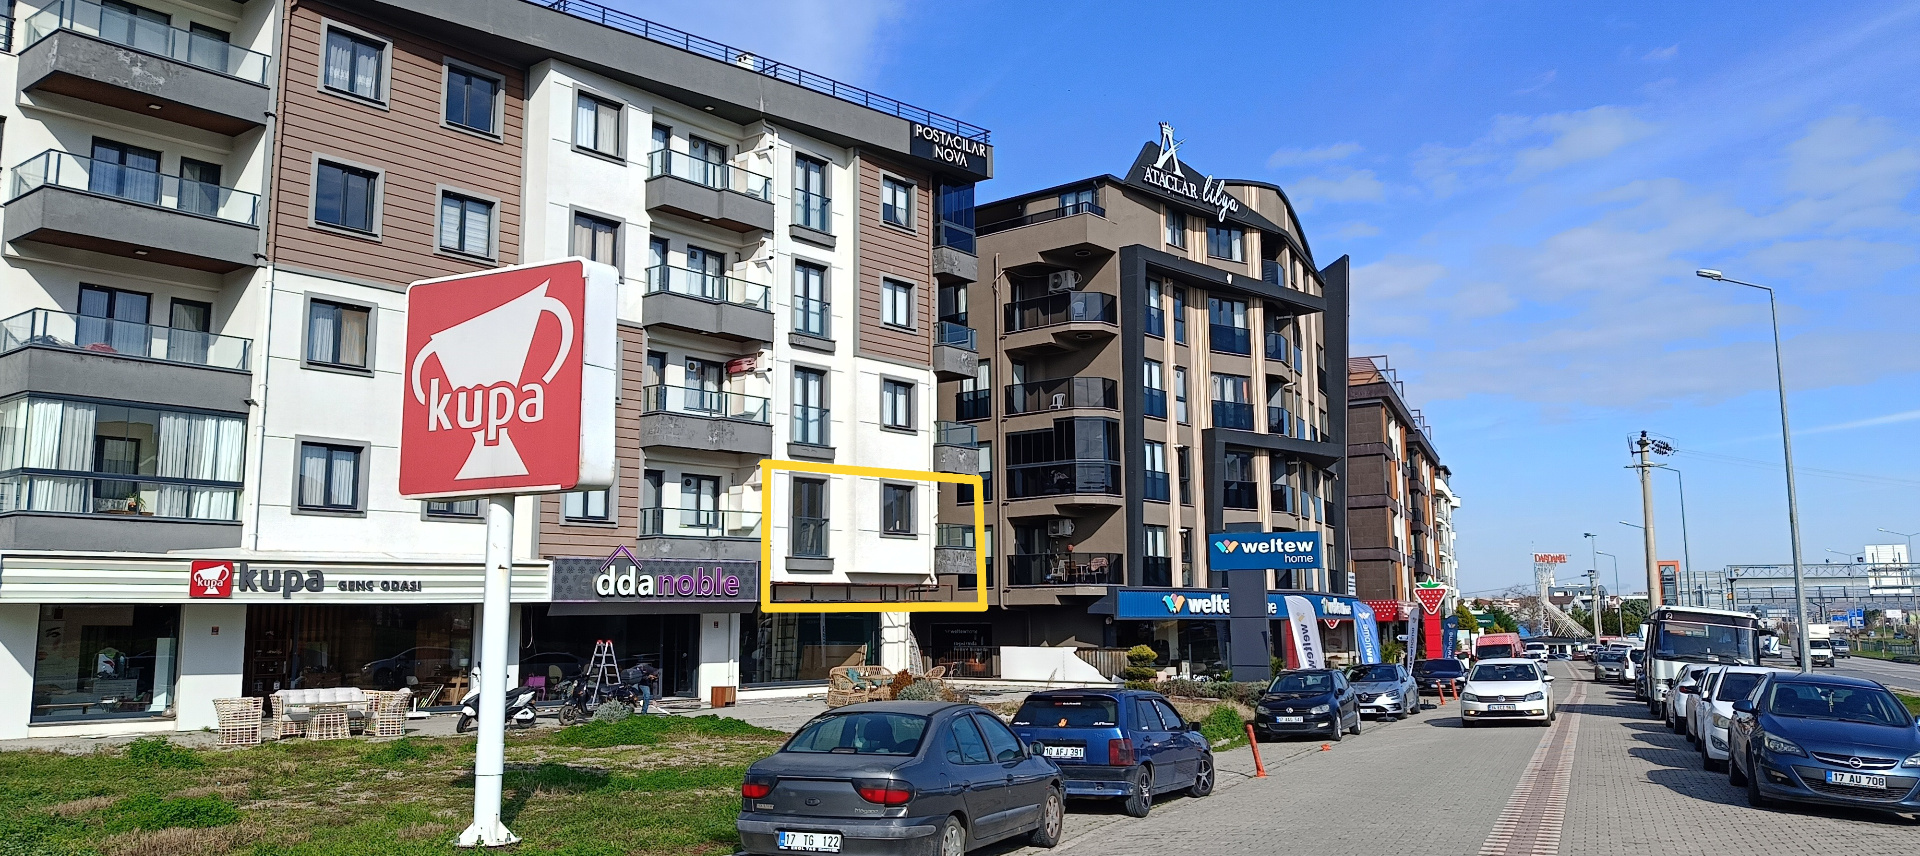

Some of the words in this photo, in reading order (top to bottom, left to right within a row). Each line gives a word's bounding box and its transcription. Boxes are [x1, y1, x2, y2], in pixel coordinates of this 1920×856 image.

[916, 124, 987, 158] POSTACILAR
[934, 144, 968, 168] NOVA
[1202, 174, 1239, 223] lilya
[428, 377, 544, 442] kupa
[1241, 538, 1314, 554] weltew
[1284, 554, 1314, 563] home
[197, 576, 224, 589] kupa
[238, 561, 325, 599] kupa
[380, 580, 422, 592] ODASI
[1187, 594, 1231, 614] welte
[1045, 747, 1053, 756] 10
[1055, 748, 1069, 756] AFJ
[1070, 748, 1082, 757] 391
[1833, 772, 1845, 782] 17
[1849, 774, 1862, 784] AU
[1865, 776, 1885, 786] 708
[786, 833, 796, 845] 17
[803, 834, 814, 846] TG
[823, 835, 839, 848] 122
